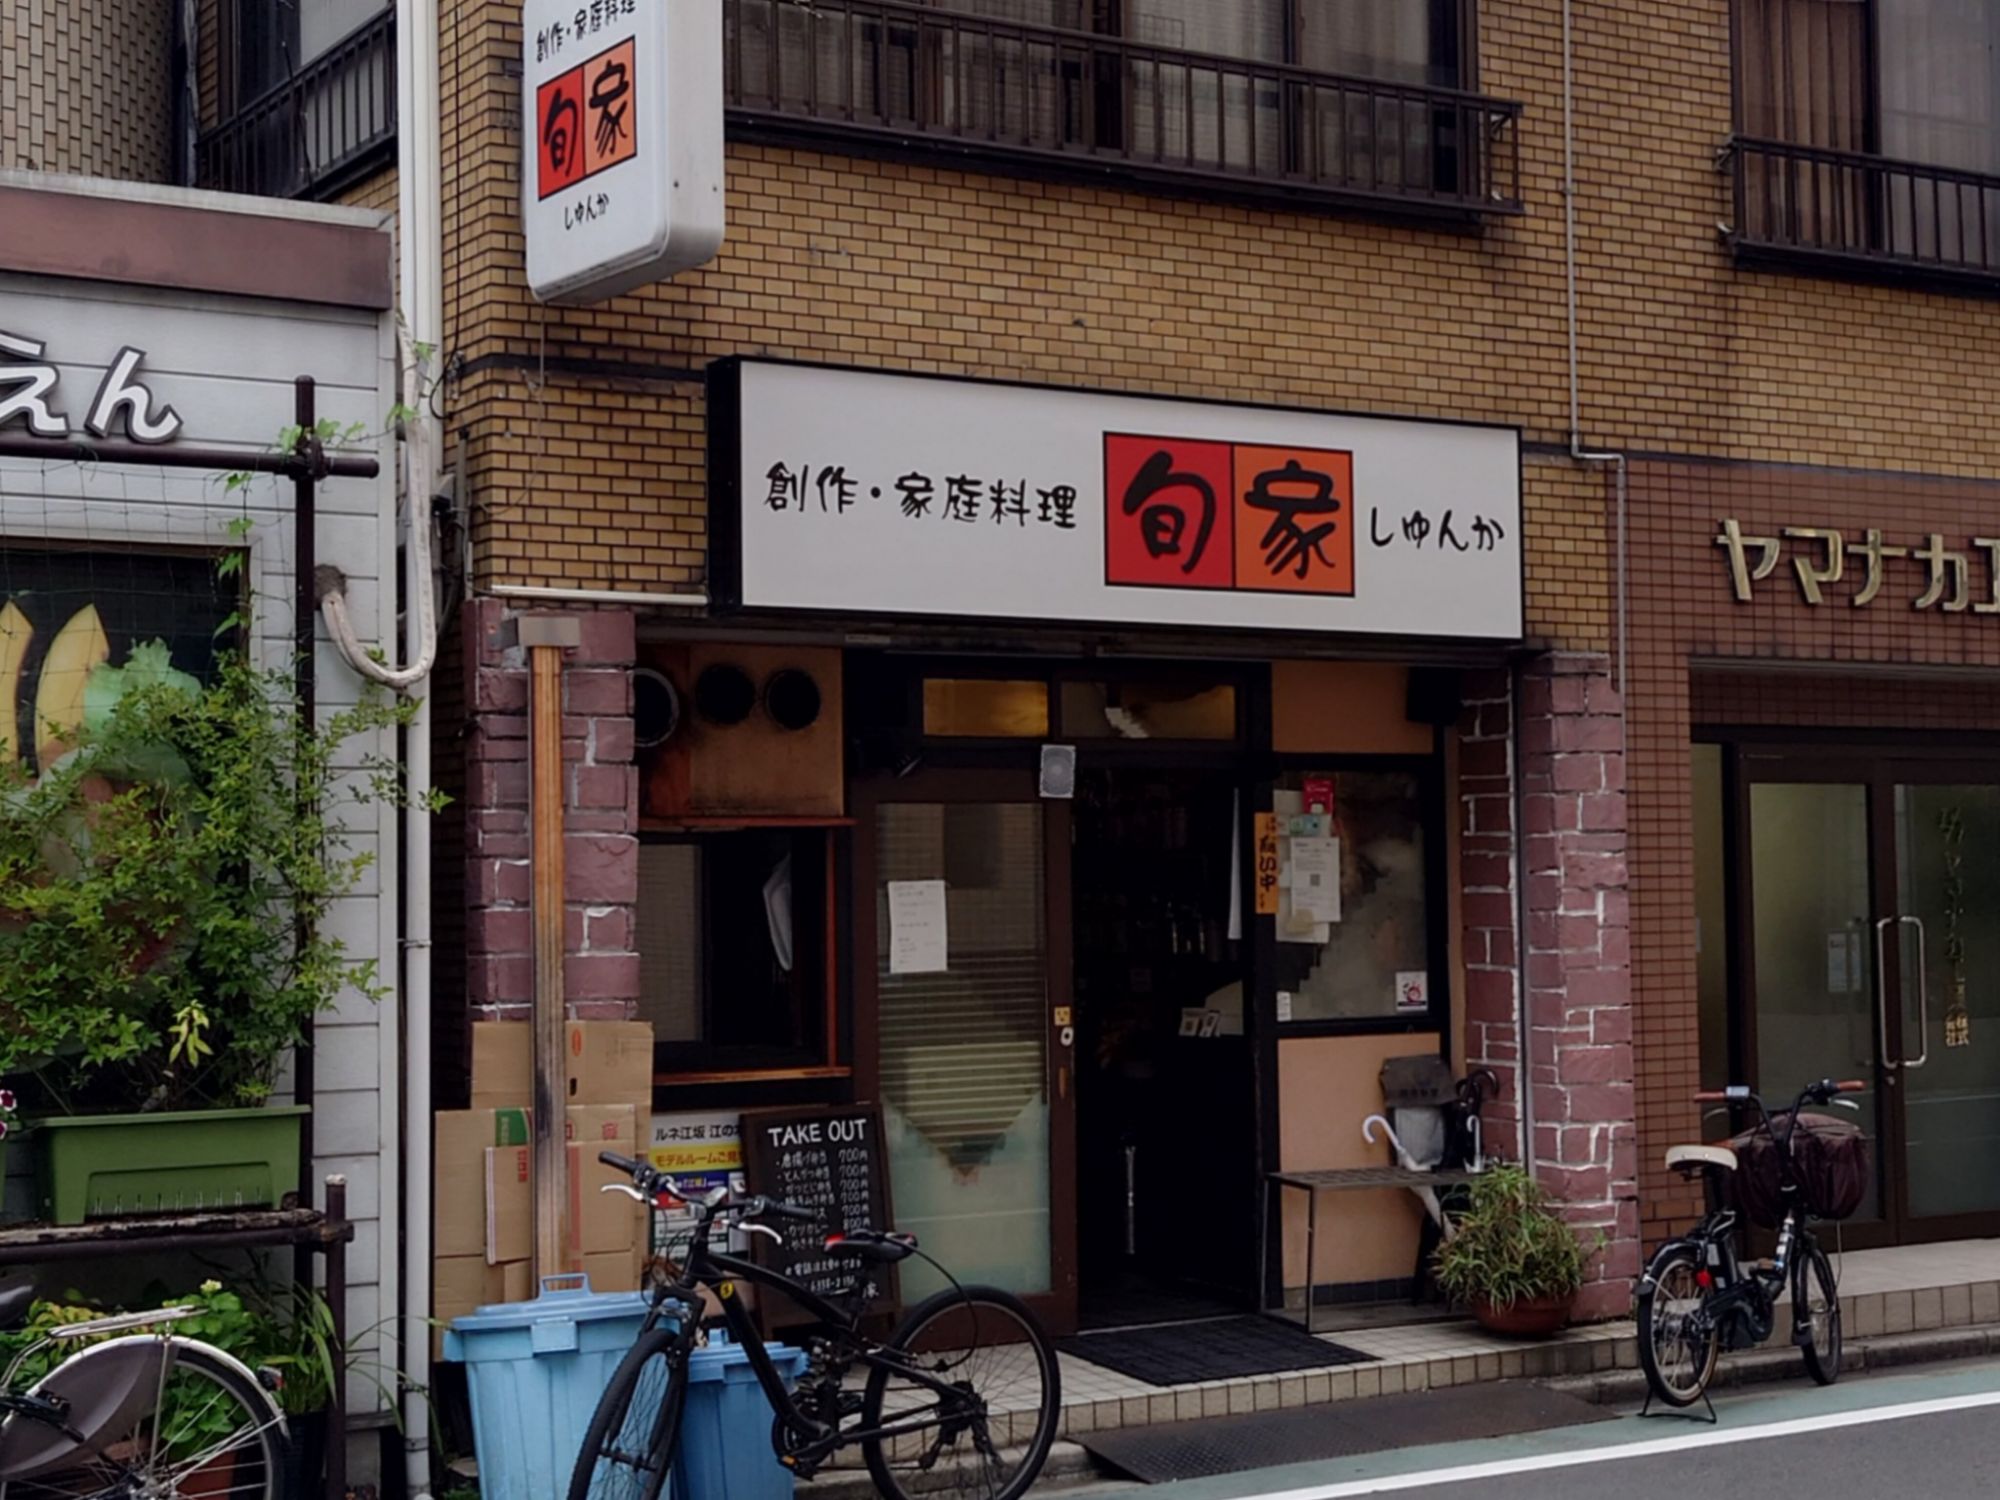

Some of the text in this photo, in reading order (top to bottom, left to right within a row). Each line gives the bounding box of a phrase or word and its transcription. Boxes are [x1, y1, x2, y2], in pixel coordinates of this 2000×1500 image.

[543, 59, 630, 177] 旬家
[564, 192, 610, 231] しゅんか
[764, 450, 1505, 580] 創作・家庭料理 旬家 しゅんか
[656, 1124, 706, 1143] ルネ江坂
[767, 1118, 867, 1148] TAKE OUT
